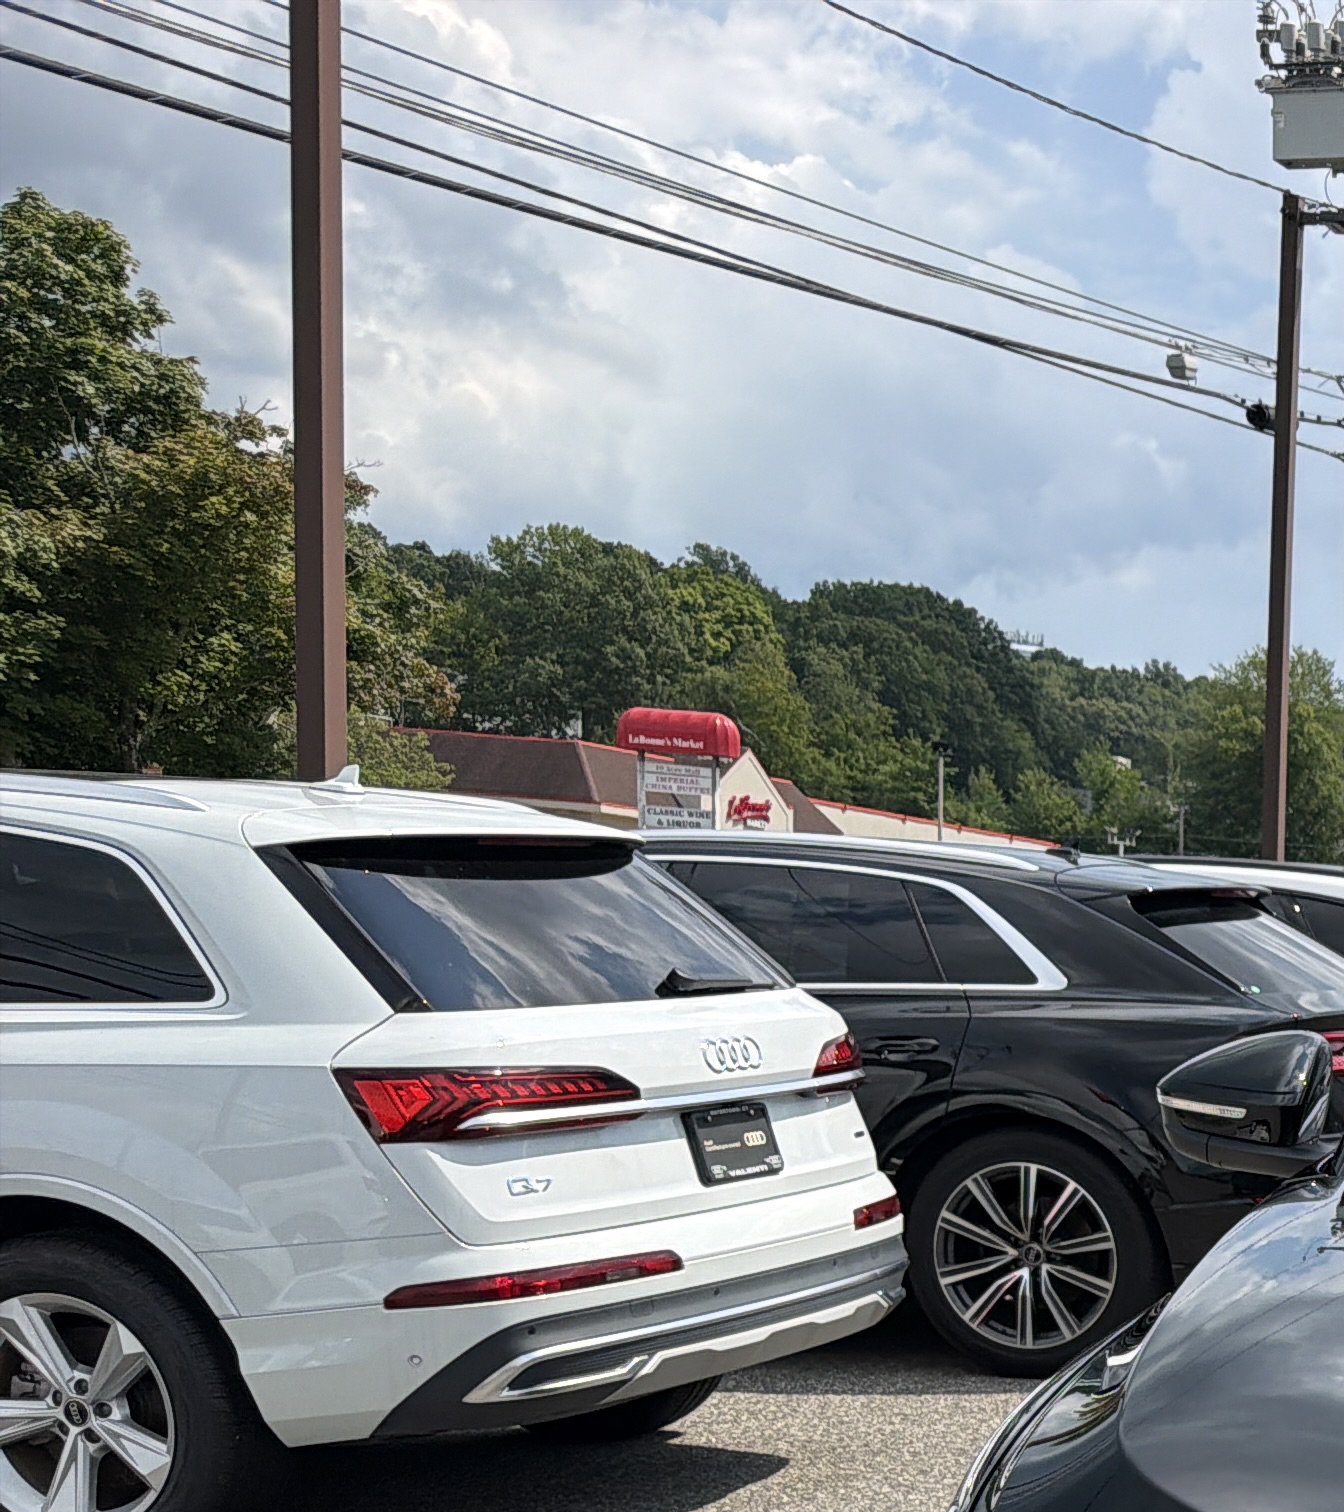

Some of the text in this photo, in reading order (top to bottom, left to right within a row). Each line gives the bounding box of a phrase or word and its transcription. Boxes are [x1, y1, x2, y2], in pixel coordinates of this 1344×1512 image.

[672, 737, 704, 750] Market
[645, 782, 673, 791] CHINA
[655, 775, 700, 786] IMPERIAL
[646, 807, 712, 820] CLASSIC WINE
[656, 817, 702, 829] & LIQUOR
[506, 1177, 552, 1197] Q7
